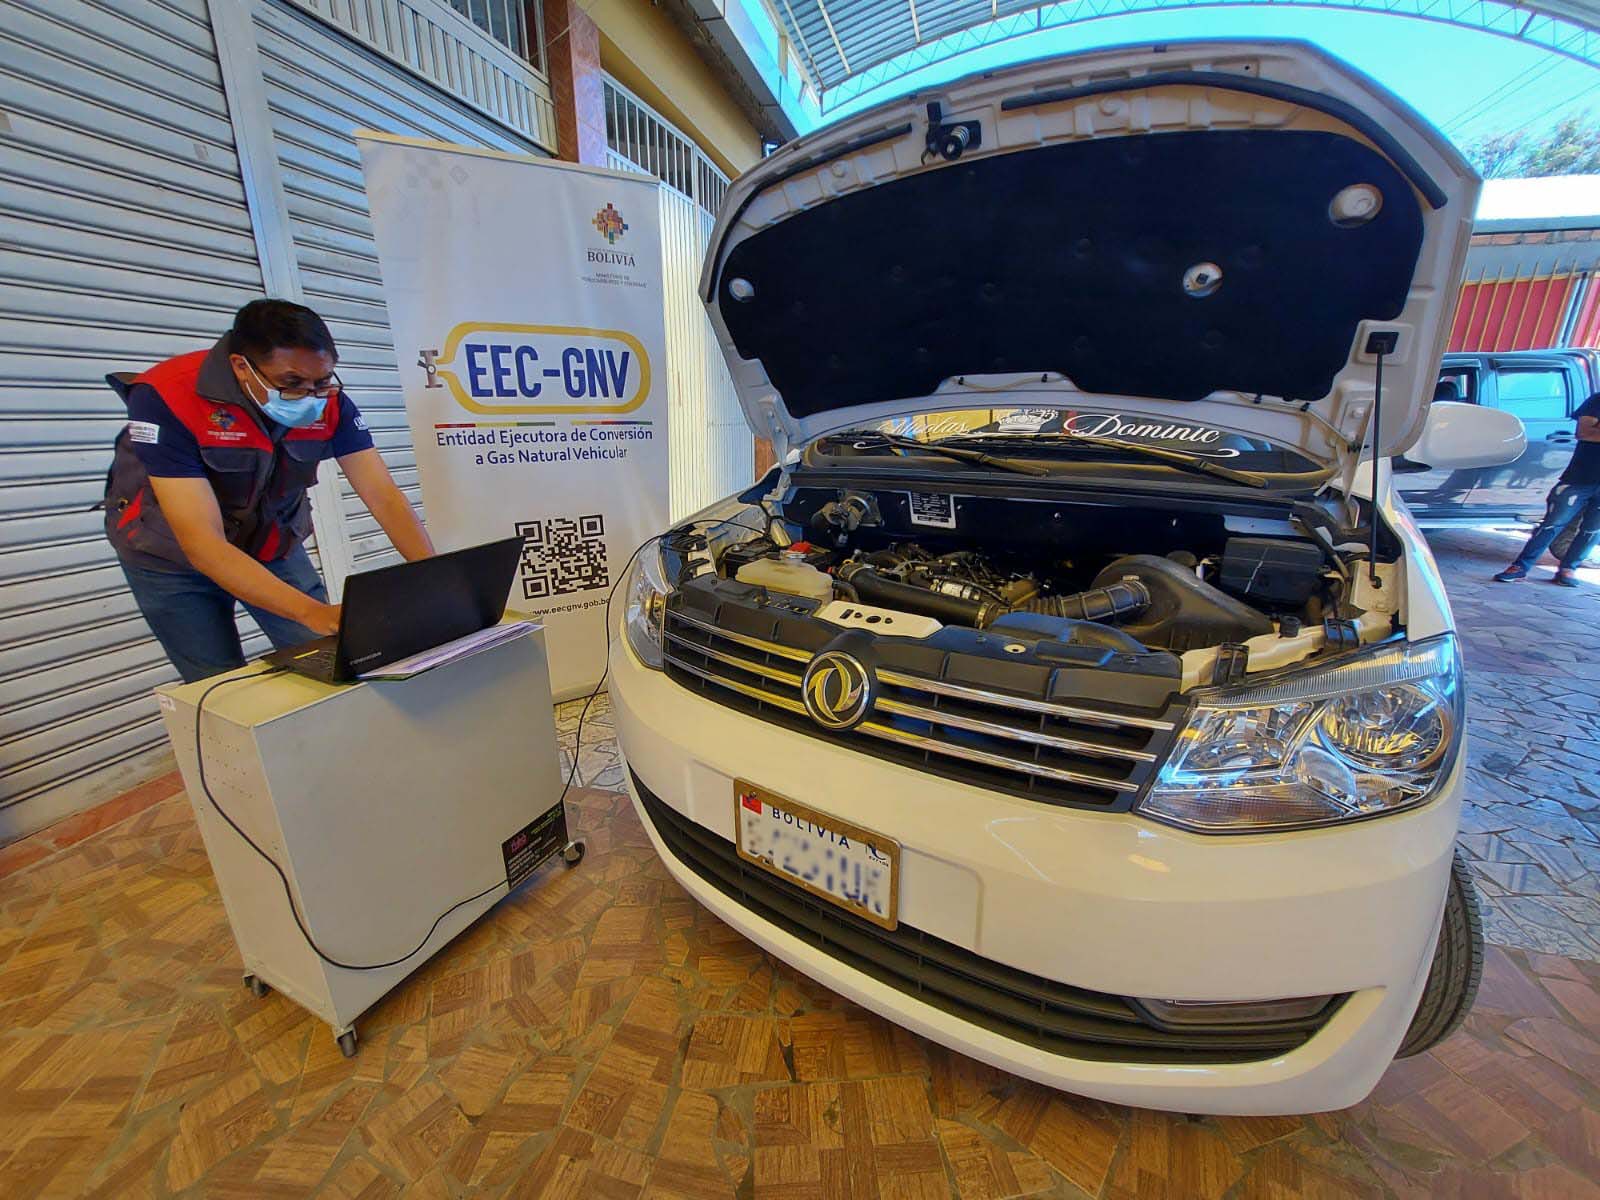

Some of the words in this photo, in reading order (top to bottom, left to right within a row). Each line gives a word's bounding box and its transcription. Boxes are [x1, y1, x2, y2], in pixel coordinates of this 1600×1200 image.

[587, 251, 636, 267] BOLIVIA
[465, 343, 630, 399] EEC-GNV
[436, 430, 496, 446] Entidad
[499, 429, 568, 448] Ejecutora
[571, 428, 587, 442] de
[589, 426, 653, 441] Conversión
[1063, 413, 1220, 443] Dominic
[475, 454, 484, 465] a
[487, 450, 515, 465] Gas
[518, 447, 571, 463] Natural
[573, 444, 628, 460] Vehicular
[529, 598, 610, 616] ww.eecgnv.gob.bo
[772, 807, 851, 850] BOLIVIA
